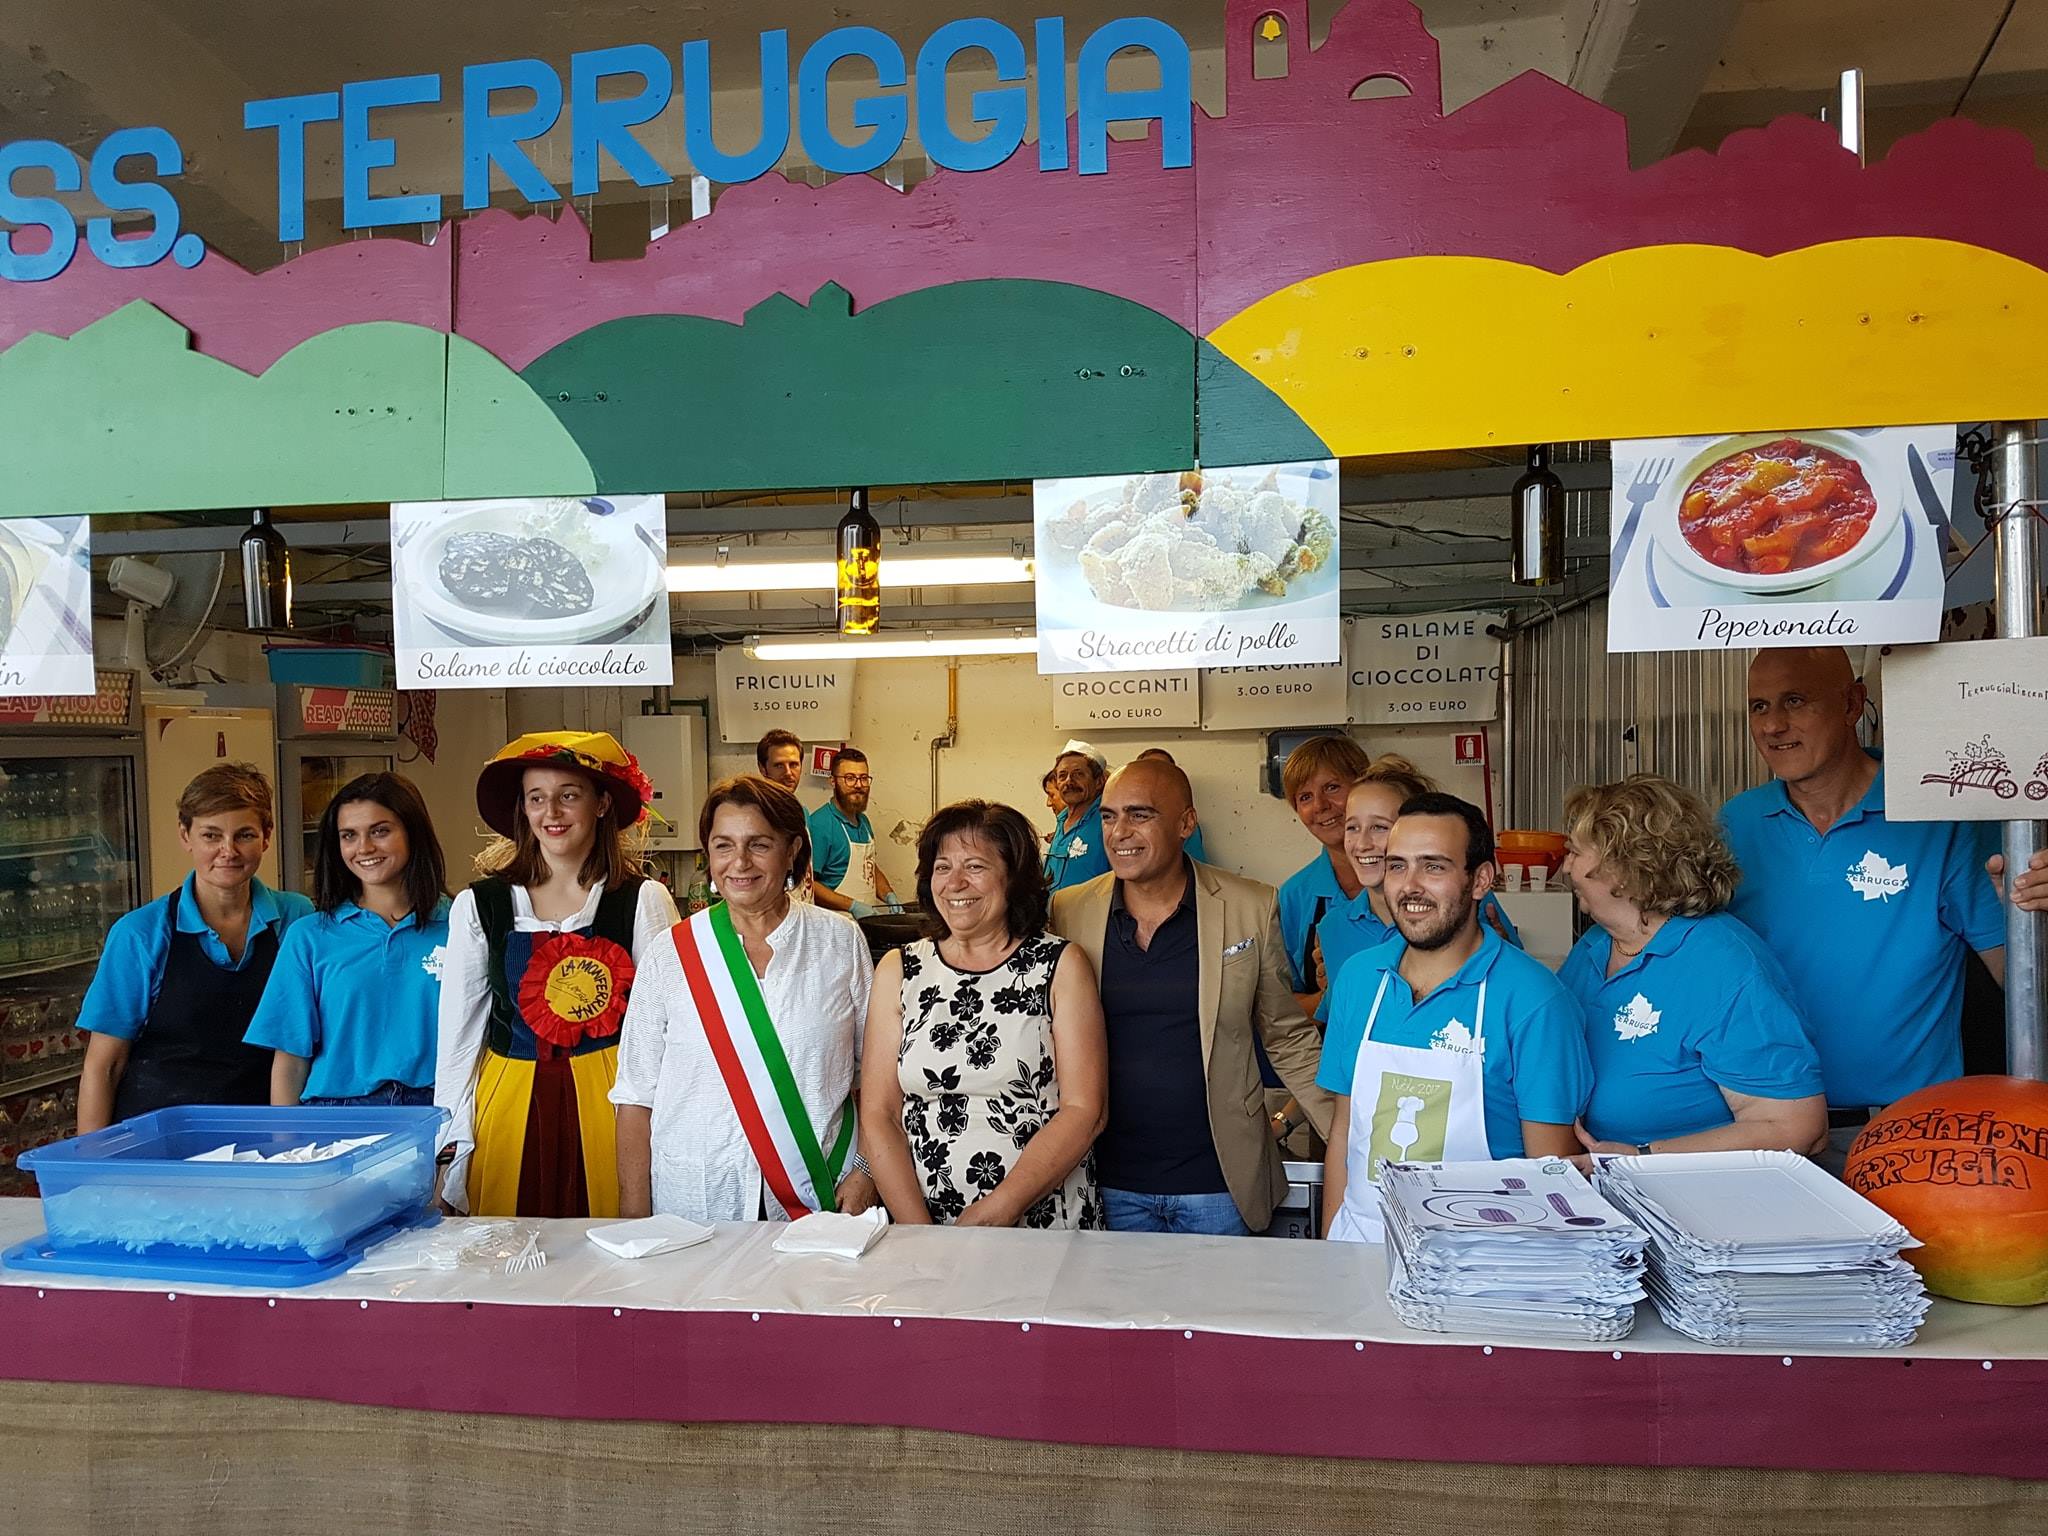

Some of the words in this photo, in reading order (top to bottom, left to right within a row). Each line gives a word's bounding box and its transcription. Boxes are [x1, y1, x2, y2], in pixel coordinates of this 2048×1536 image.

[244, 16, 1192, 242] TERRUGGIA
[1381, 620, 1474, 639] SALAME
[1696, 607, 1860, 646] Peperonata
[1077, 630, 1199, 659] Straccetti
[1205, 624, 1232, 652] di
[1236, 621, 1299, 659] pollo
[1417, 645, 1439, 661] DI
[417, 651, 502, 680] Salame
[507, 650, 532, 676] di
[538, 649, 648, 676] cioccolato
[735, 674, 836, 690] FRICIULIN
[1351, 666, 1500, 686] CIOCCOLATO
[1062, 677, 1189, 696] CROCCANTI
[1237, 685, 1270, 697] 3.00
[1276, 683, 1313, 694] EURO
[95, 689, 125, 714] GO
[753, 701, 780, 711] 3.50
[786, 700, 819, 711] EURO
[1388, 702, 1423, 712] 3.00
[1429, 700, 1467, 711] EURO
[304, 704, 350, 724] READY
[353, 705, 370, 724] TO
[371, 705, 389, 725] GO
[1089, 709, 1122, 720] 4.00
[1127, 707, 1162, 718] EURO
[1847, 864, 1871, 875] ASS.
[1845, 873, 1910, 888] TERRUGGIA
[561, 959, 576, 978] LA
[568, 959, 609, 1020] MONFERRINA
[1617, 1004, 1636, 1017] ASS.
[1847, 1148, 2032, 1196] TERRUGGIA
